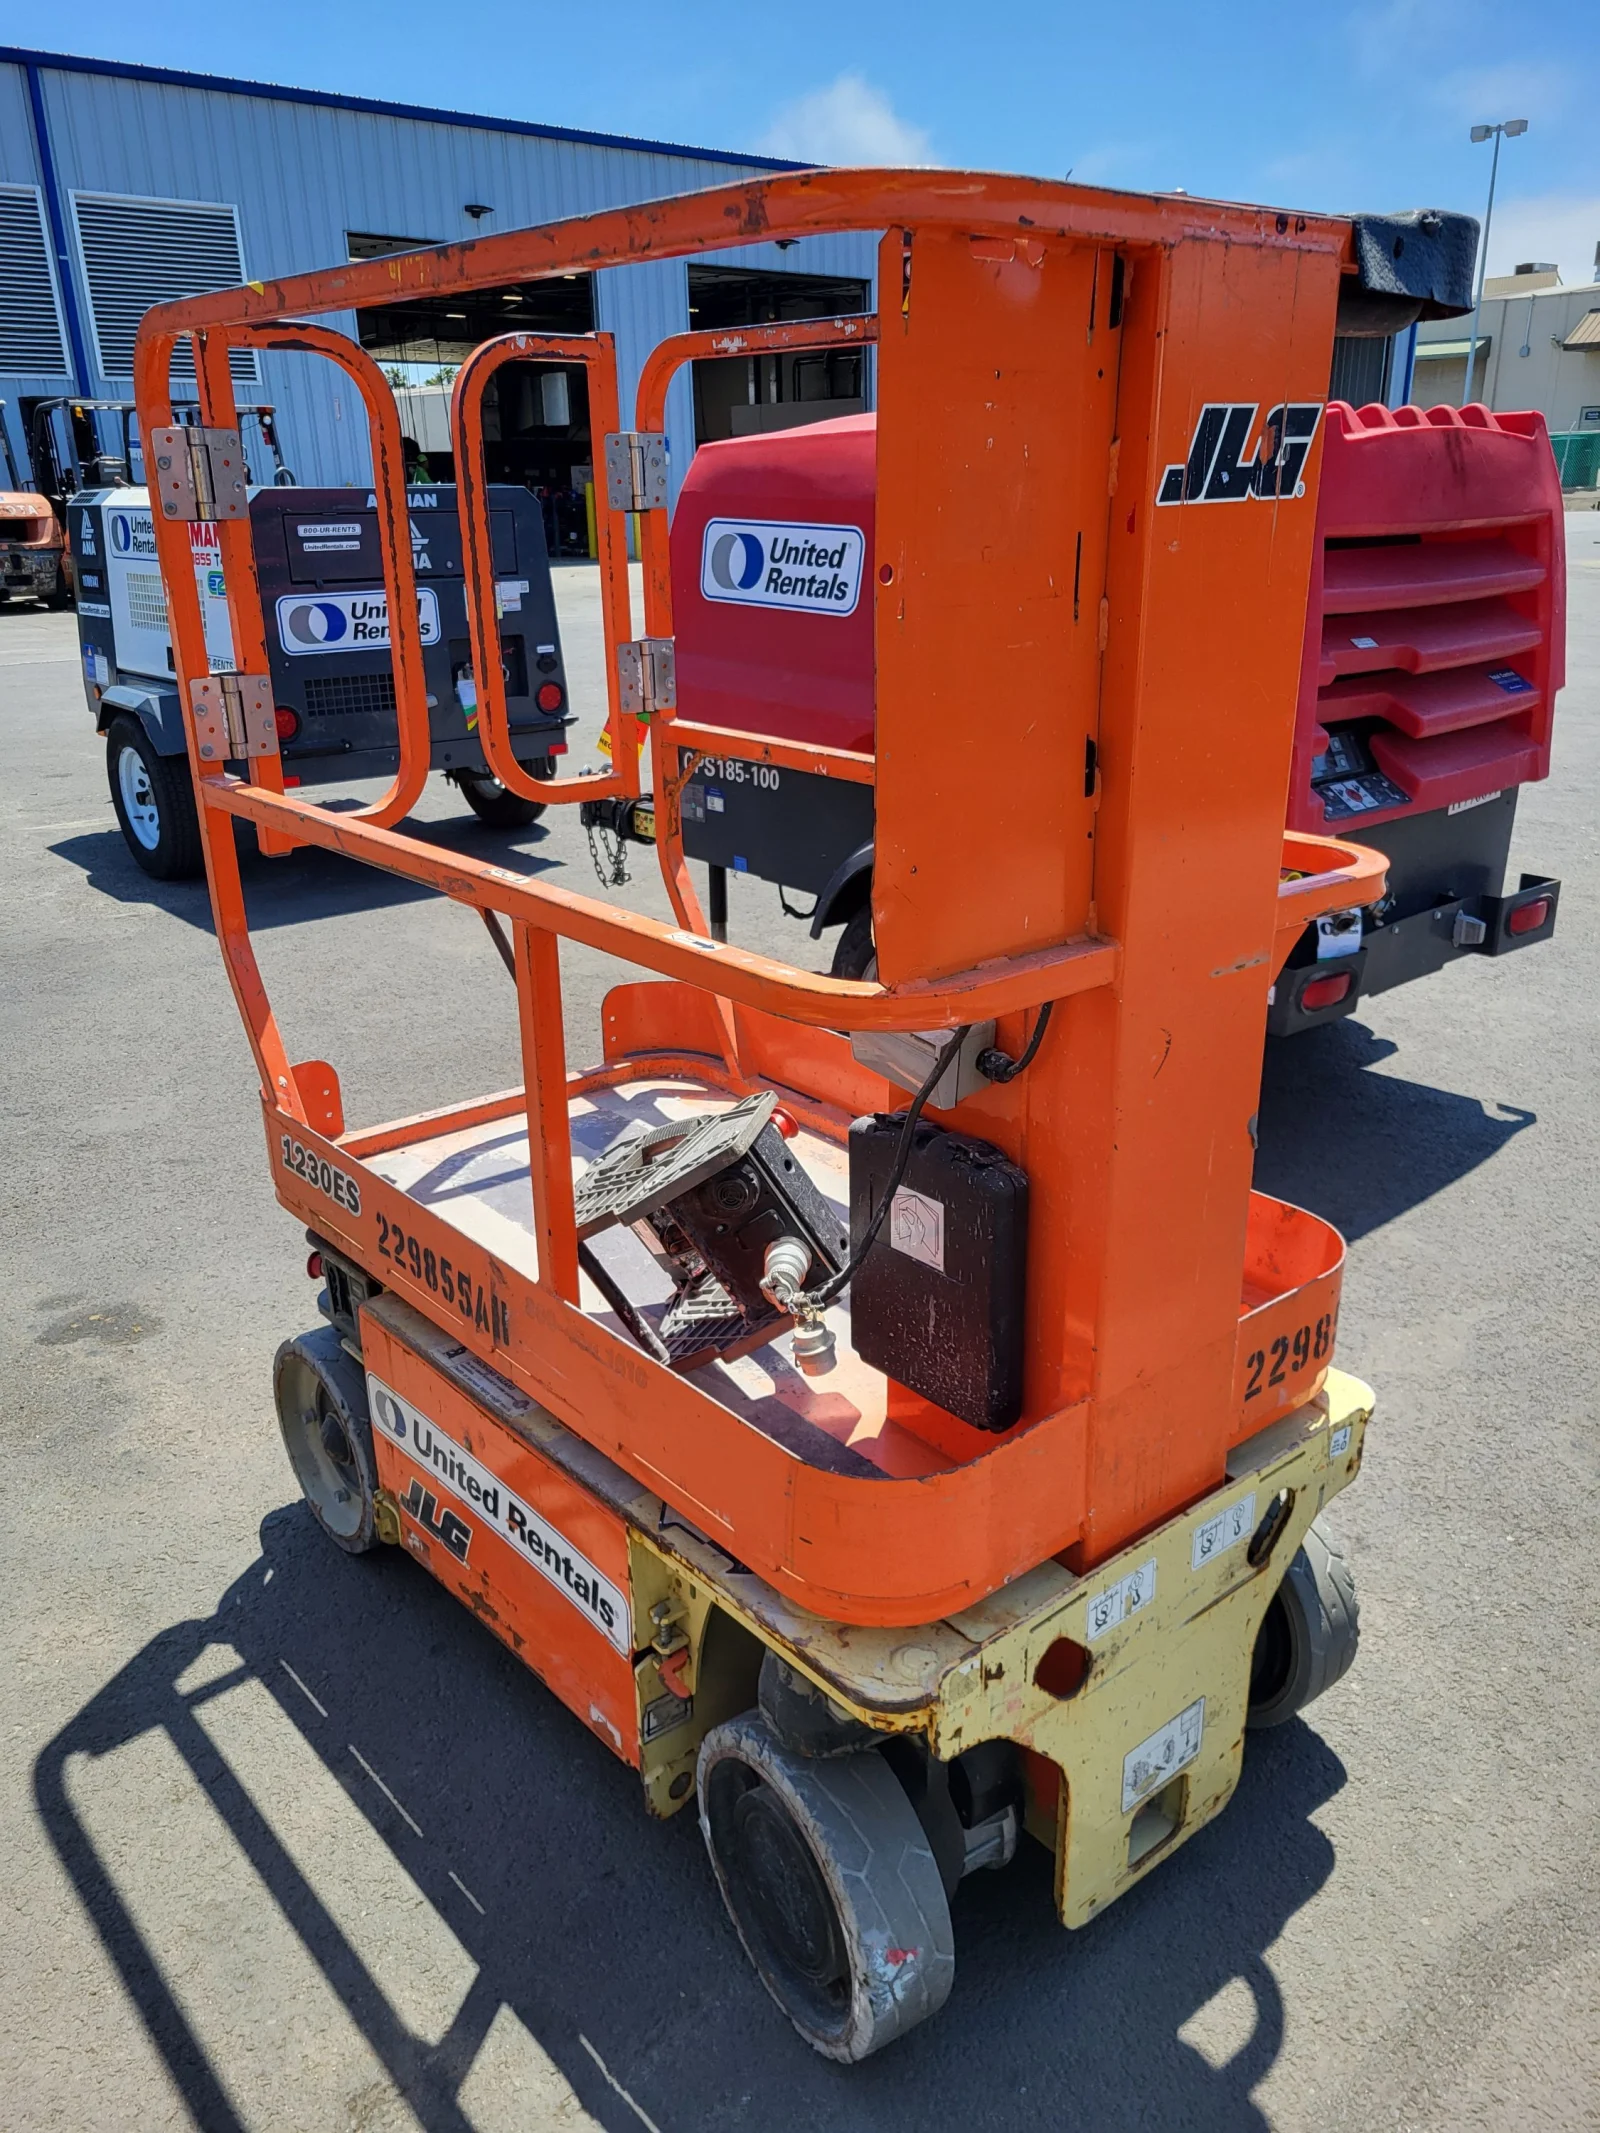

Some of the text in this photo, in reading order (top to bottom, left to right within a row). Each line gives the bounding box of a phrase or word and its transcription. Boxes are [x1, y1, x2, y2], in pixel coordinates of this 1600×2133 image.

[1157, 404, 1322, 505] JLG
[366, 493, 438, 508] AAN
[132, 535, 157, 553] Rental
[303, 526, 357, 534] 800-UR-RENTS
[82, 541, 97, 556] ANA
[304, 543, 361, 551] UnitedRentals.com
[770, 537, 847, 569] United
[764, 567, 849, 601] Rentals
[351, 599, 422, 620] Uni
[281, 1134, 361, 1216] 1230ES
[1244, 1311, 1337, 1403] 2298
[400, 1478, 473, 1564] JLG
[413, 1419, 615, 1628] United Rentals
